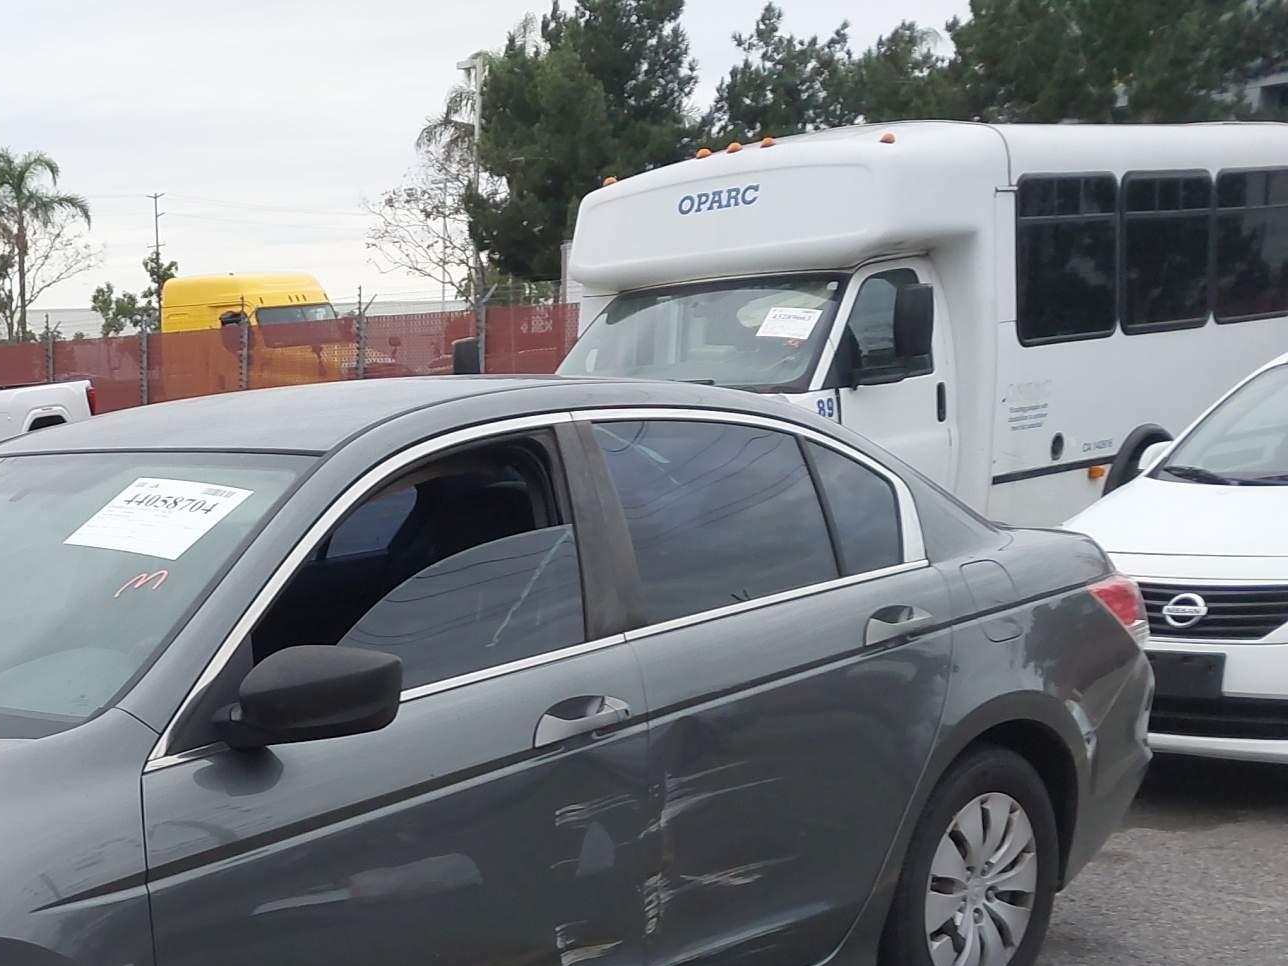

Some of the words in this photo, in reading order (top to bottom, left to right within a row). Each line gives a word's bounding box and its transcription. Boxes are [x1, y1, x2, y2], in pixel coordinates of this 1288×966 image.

[678, 184, 761, 216] OPARC
[817, 397, 834, 418] 89
[123, 492, 219, 515] 44058704
